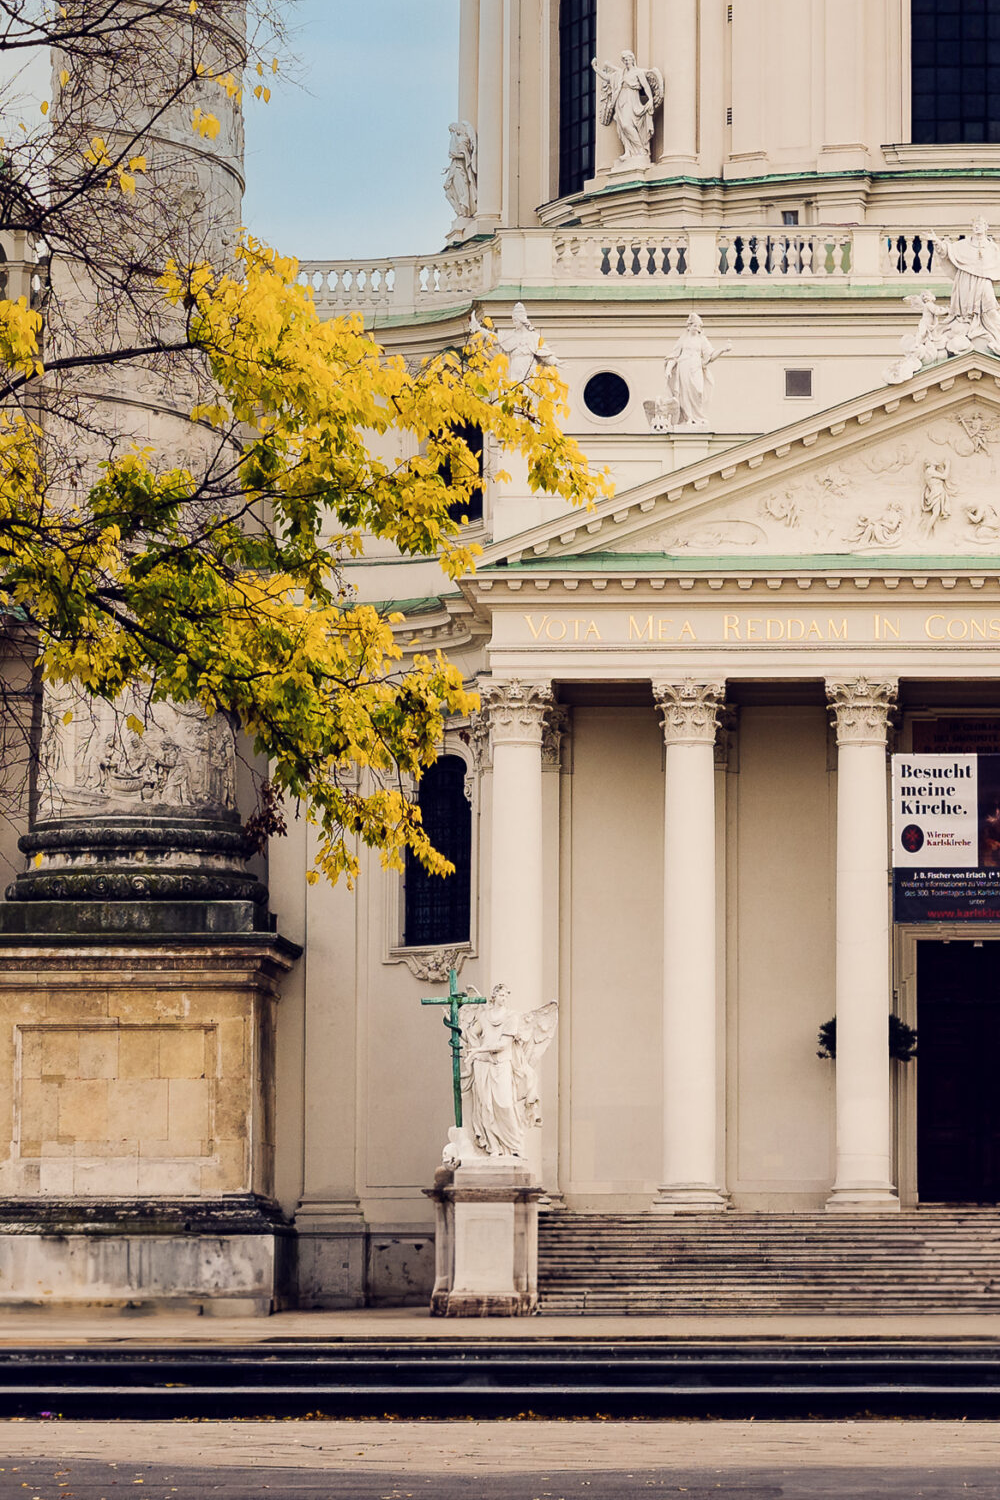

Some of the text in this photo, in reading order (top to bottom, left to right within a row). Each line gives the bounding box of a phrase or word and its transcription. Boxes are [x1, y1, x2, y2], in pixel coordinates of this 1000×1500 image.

[524, 614, 602, 641] VOTA
[629, 614, 697, 641] MEA
[723, 614, 848, 640] REDDAM
[873, 613, 901, 639] IN
[901, 763, 973, 779] Besucht
[900, 782, 956, 797] meine
[901, 799, 968, 815] Kirche.
[927, 831, 955, 839] Wiener
[927, 839, 972, 847] Karlskirche
[914, 872, 919, 880] J.
[966, 871, 986, 879] Erlach
